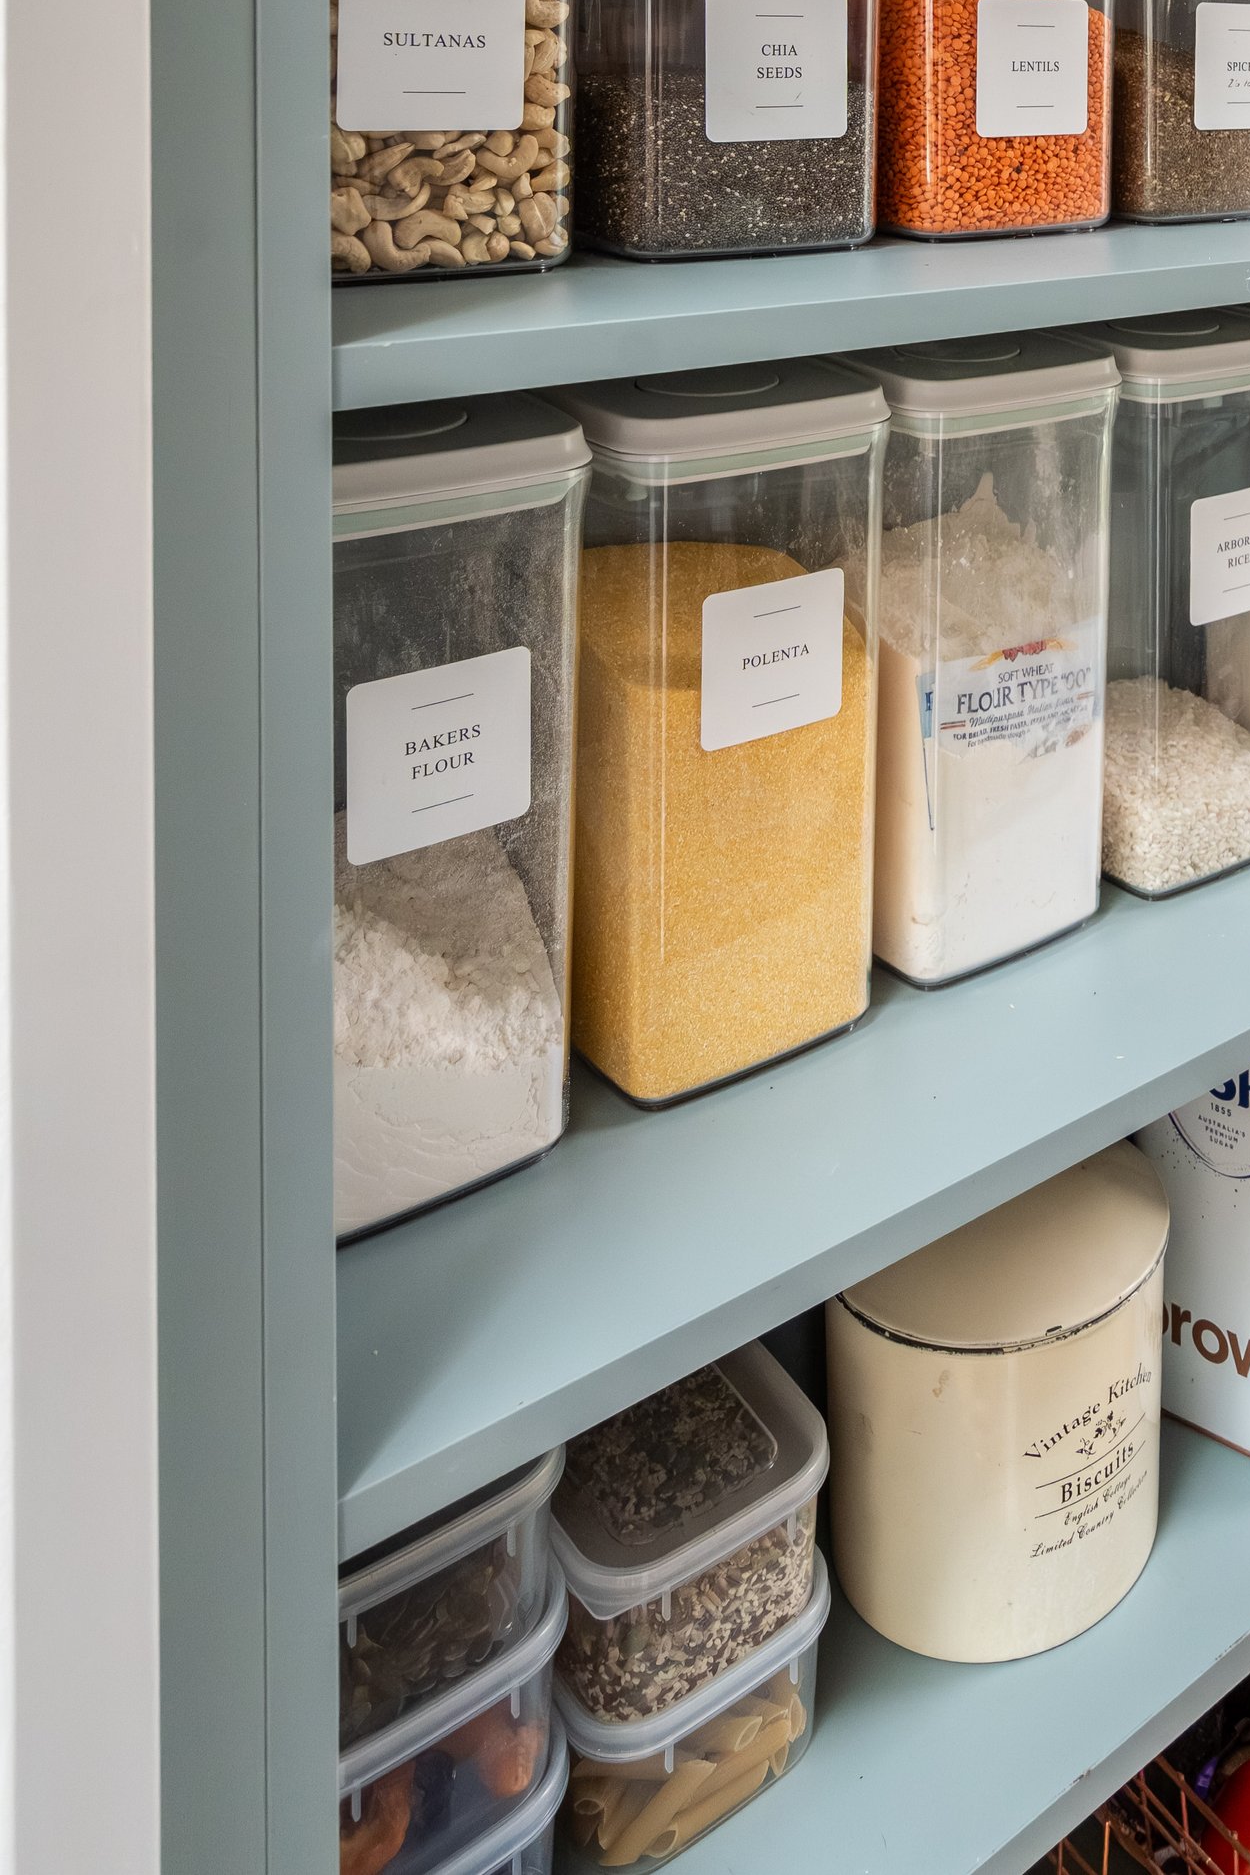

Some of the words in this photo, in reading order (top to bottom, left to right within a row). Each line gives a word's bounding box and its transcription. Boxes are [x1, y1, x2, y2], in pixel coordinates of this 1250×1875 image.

[383, 32, 486, 48] SULTANAS
[761, 44, 798, 56] CHIA
[757, 67, 803, 79] SEEDS
[1011, 61, 1060, 72] LENTILS
[1226, 553, 1250, 570] RICE
[742, 643, 810, 671] POLENTA
[998, 669, 1020, 684] SOFT
[1021, 663, 1054, 678] WHEAT
[956, 686, 1014, 715] FLOUR
[1017, 676, 1058, 703] TYPE
[969, 709, 1024, 728] Multipurpose
[404, 724, 481, 756] BAKERS
[411, 751, 475, 780] FLOUR
[1210, 1102, 1232, 1117] 1855
[1198, 1114, 1246, 1138] AUSTRALIA'S
[1205, 1126, 1239, 1143] PREMIUM
[1209, 1135, 1234, 1150] SUGAR
[1023, 1401, 1101, 1461] Vintage
[1107, 1362, 1152, 1405] Kitchen
[1060, 1441, 1135, 1505] Biscuits
[1064, 1496, 1100, 1526] English
[1030, 1531, 1074, 1559] Limited
[1077, 1511, 1115, 1540] Country
